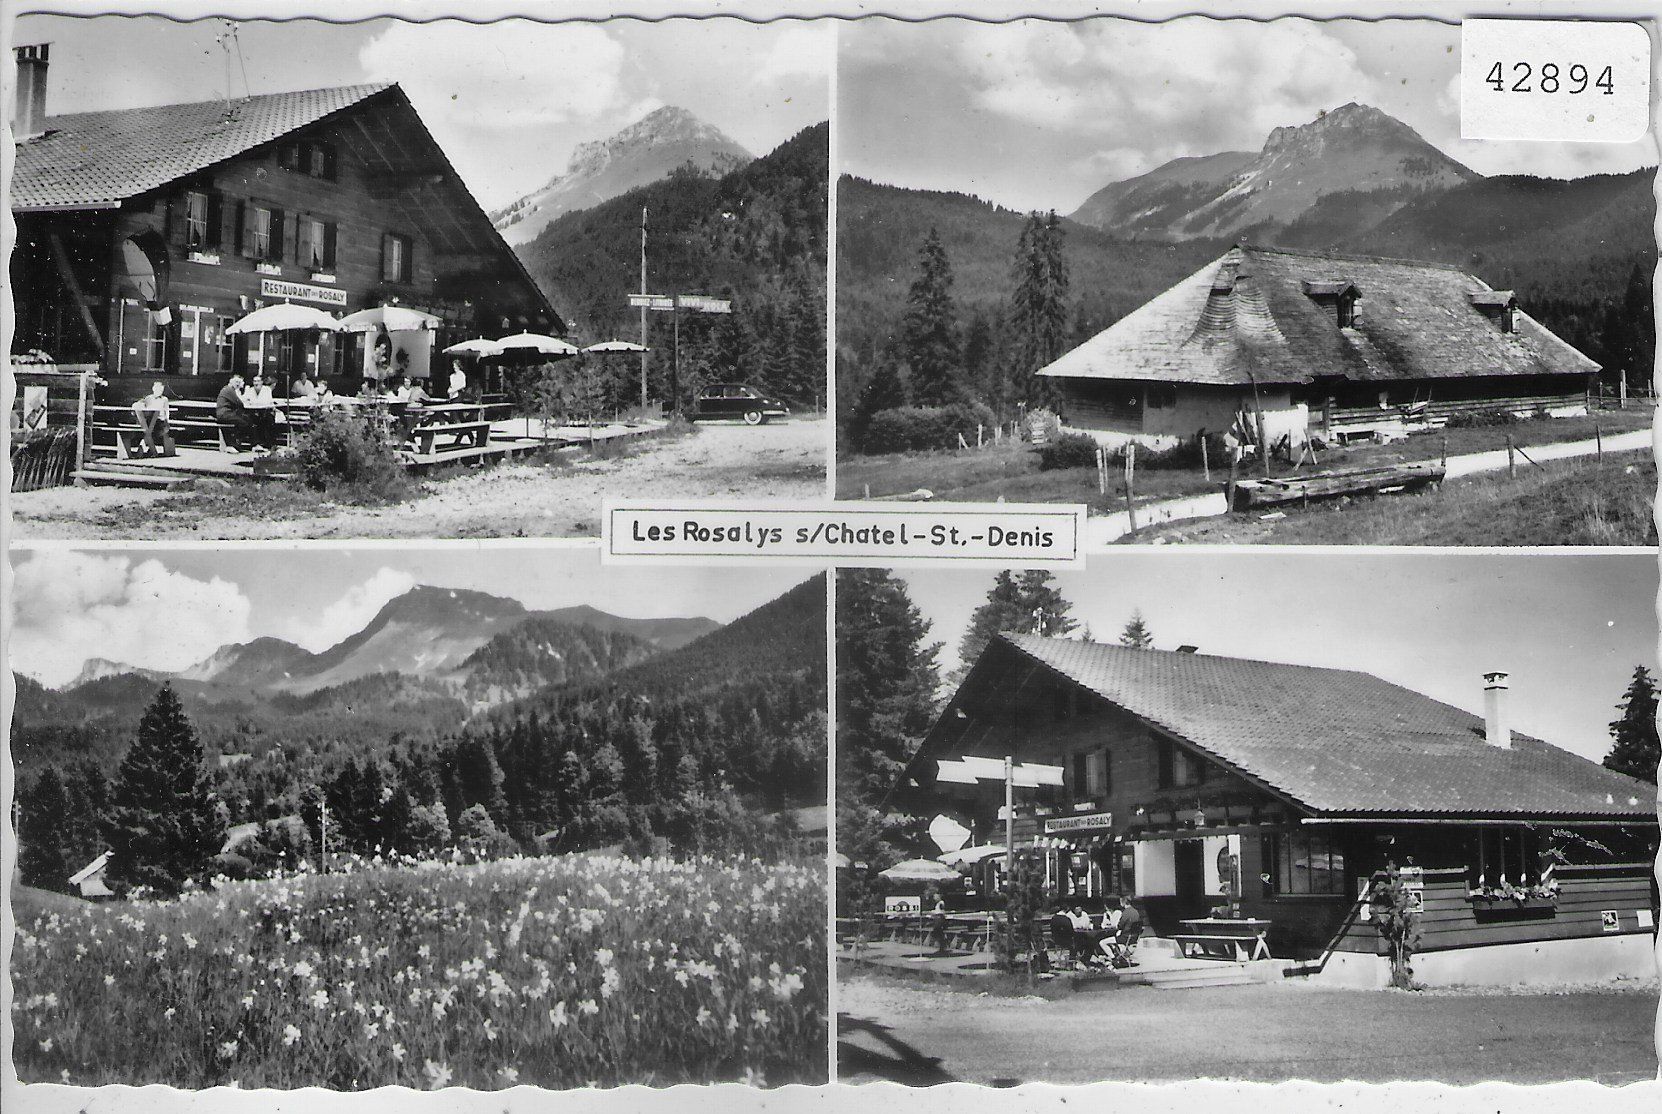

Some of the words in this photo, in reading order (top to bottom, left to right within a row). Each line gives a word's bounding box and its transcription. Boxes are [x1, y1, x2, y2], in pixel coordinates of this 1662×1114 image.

[1485, 61, 1614, 95] 42894
[264, 282, 311, 298] RESTAURANT
[318, 290, 344, 302] ROSALY
[1086, 816, 1111, 826] ROSALY
